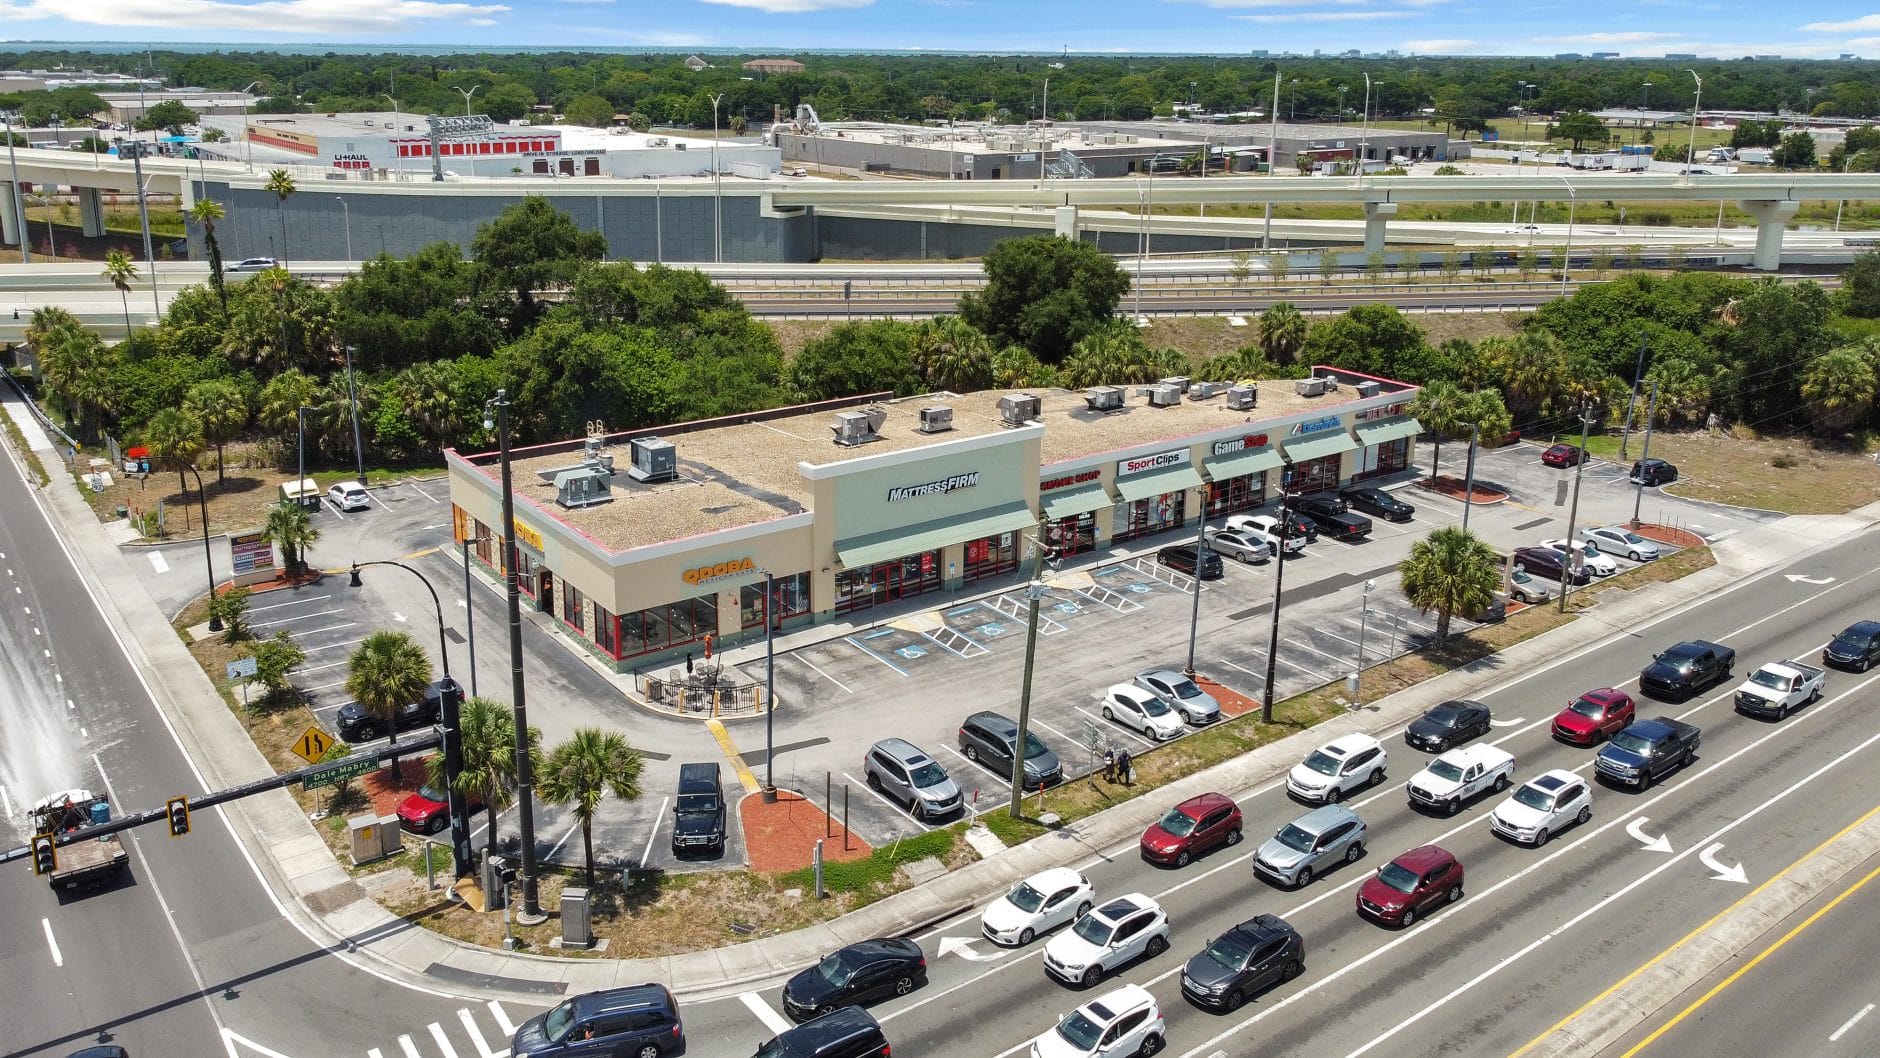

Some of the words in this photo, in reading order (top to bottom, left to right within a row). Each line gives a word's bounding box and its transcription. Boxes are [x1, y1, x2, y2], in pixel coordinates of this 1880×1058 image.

[1040, 476, 1074, 491] SMOKE
[1075, 470, 1101, 483] SHOP
[682, 557, 753, 585] QDOBA
[314, 770, 336, 780] Dale
[340, 762, 369, 774] Mabry
[308, 780, 328, 789] 4700
